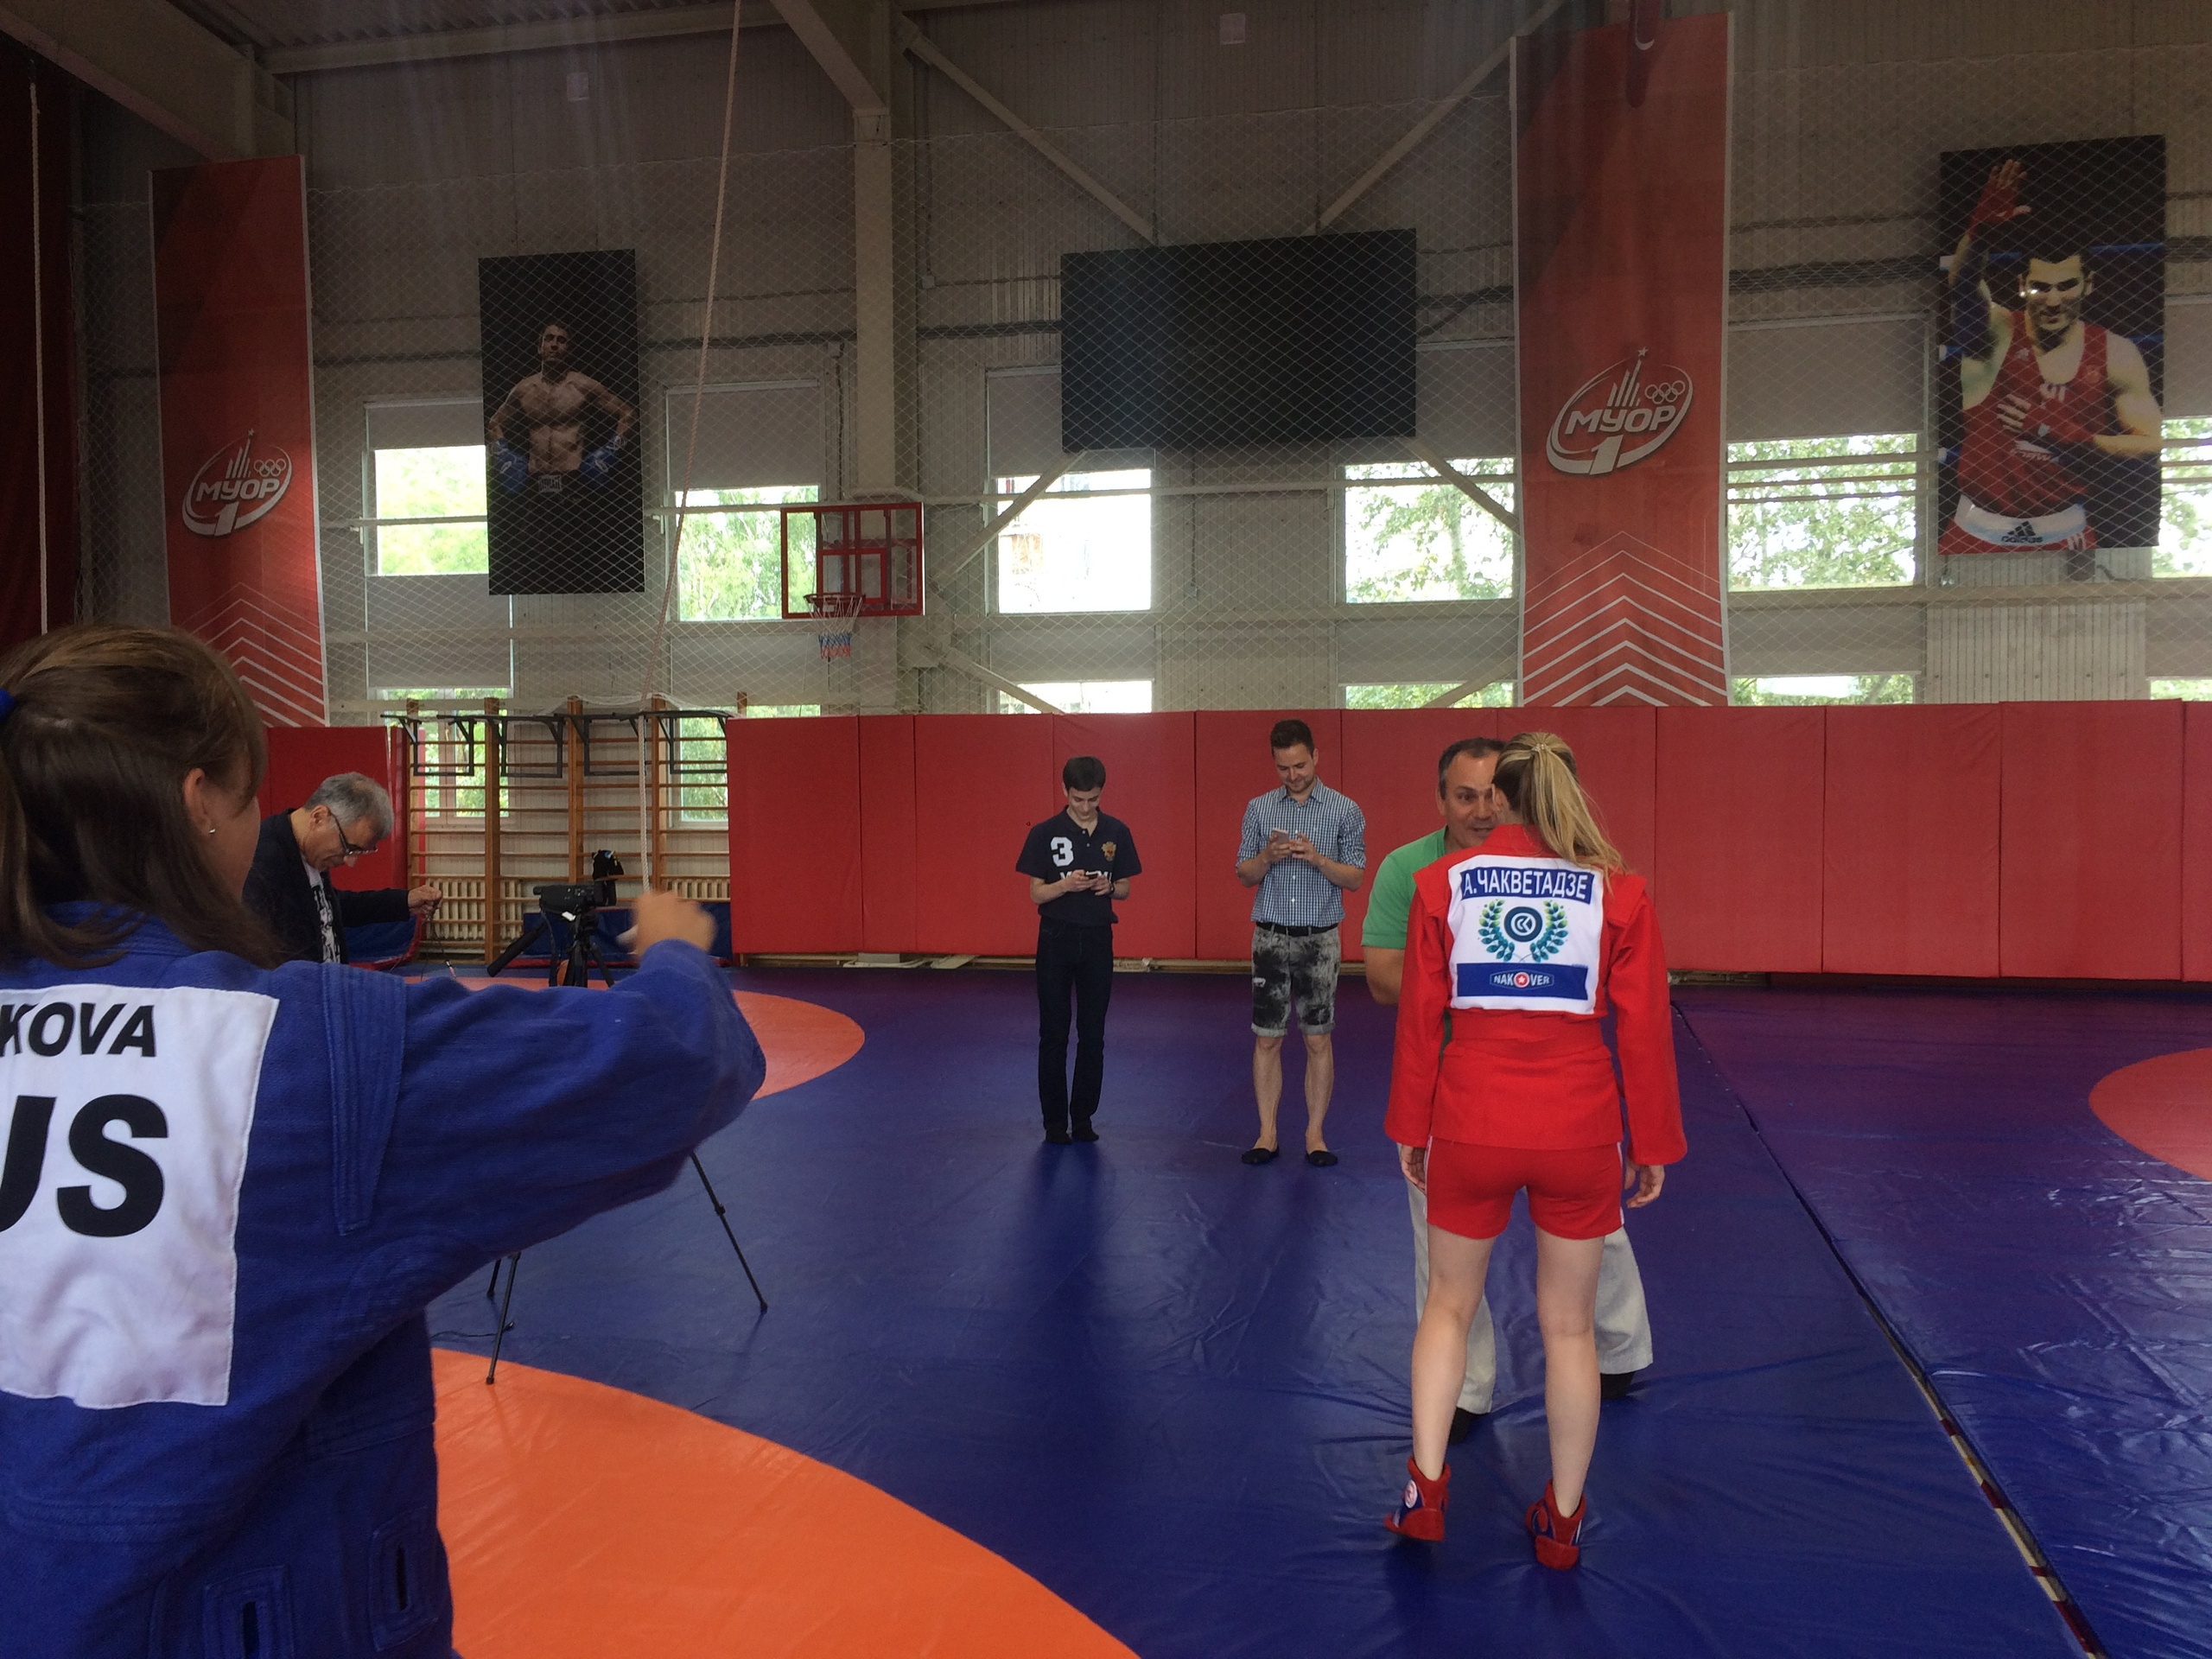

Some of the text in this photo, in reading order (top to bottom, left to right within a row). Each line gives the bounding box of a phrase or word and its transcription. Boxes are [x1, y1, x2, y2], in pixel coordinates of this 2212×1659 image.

[1565, 405, 1676, 435] МУОР
[195, 478, 280, 502] МУОР
[1050, 836, 1074, 868] 3
